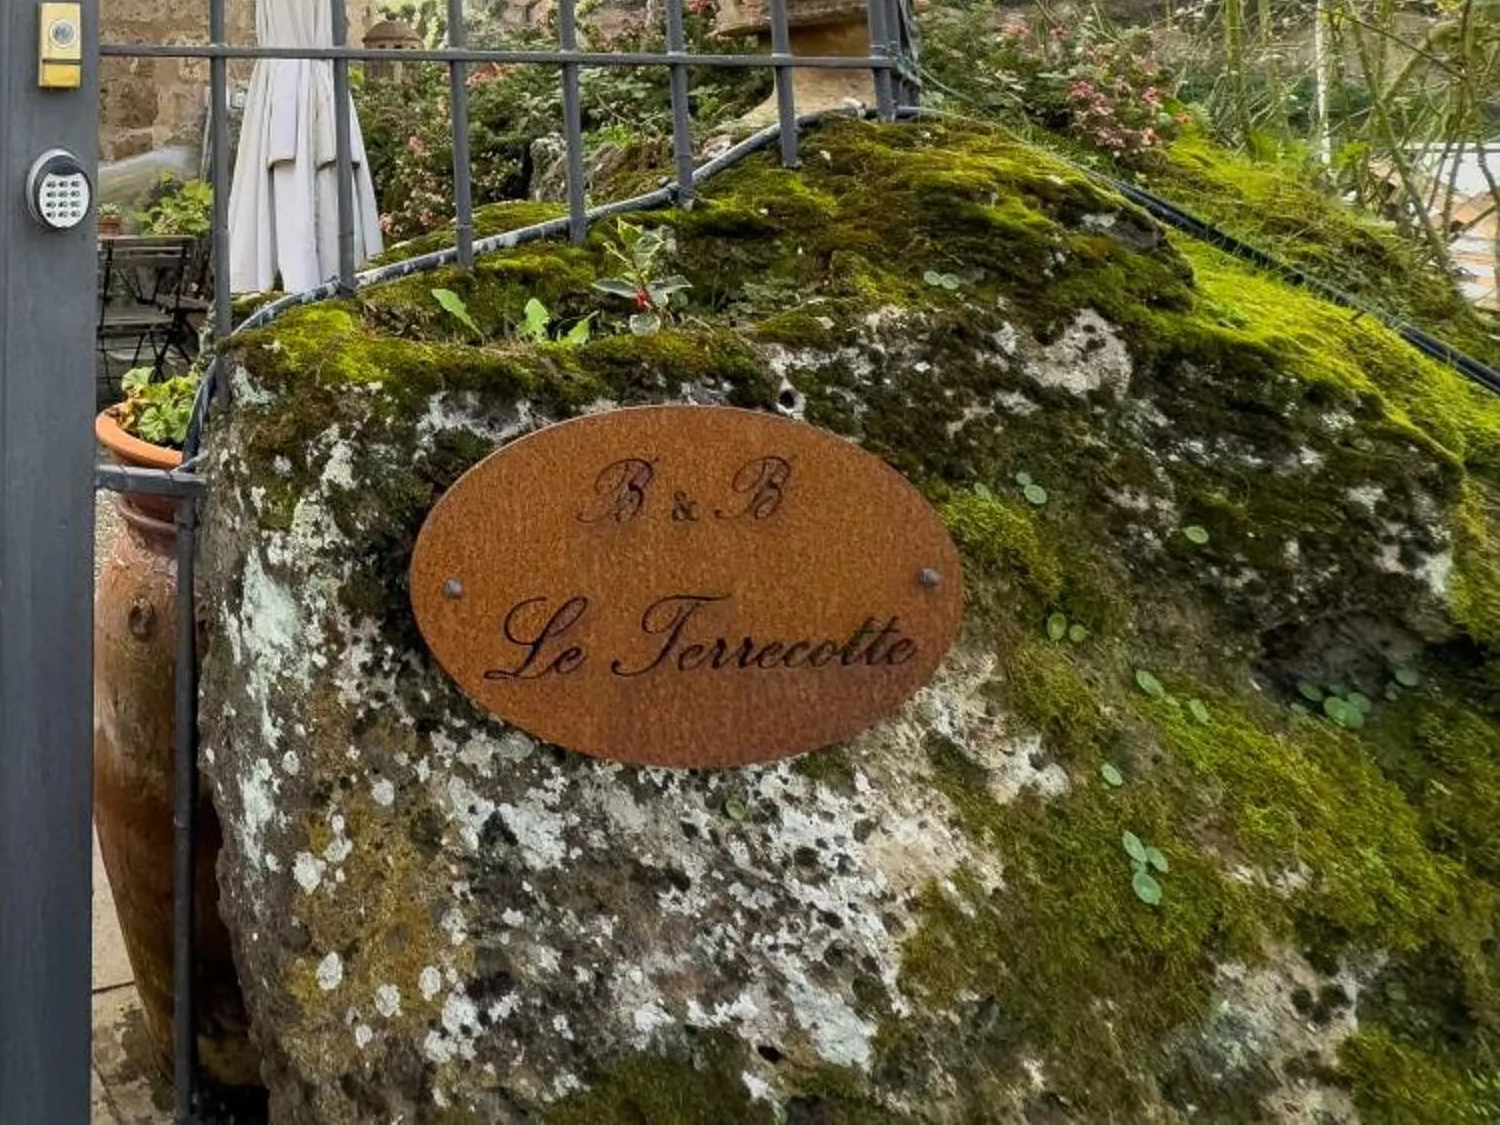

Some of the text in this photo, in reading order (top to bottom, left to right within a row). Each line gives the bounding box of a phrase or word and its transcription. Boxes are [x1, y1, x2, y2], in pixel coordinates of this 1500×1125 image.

[576, 455, 800, 525] B & B
[483, 593, 920, 681] Le Terrecotte
